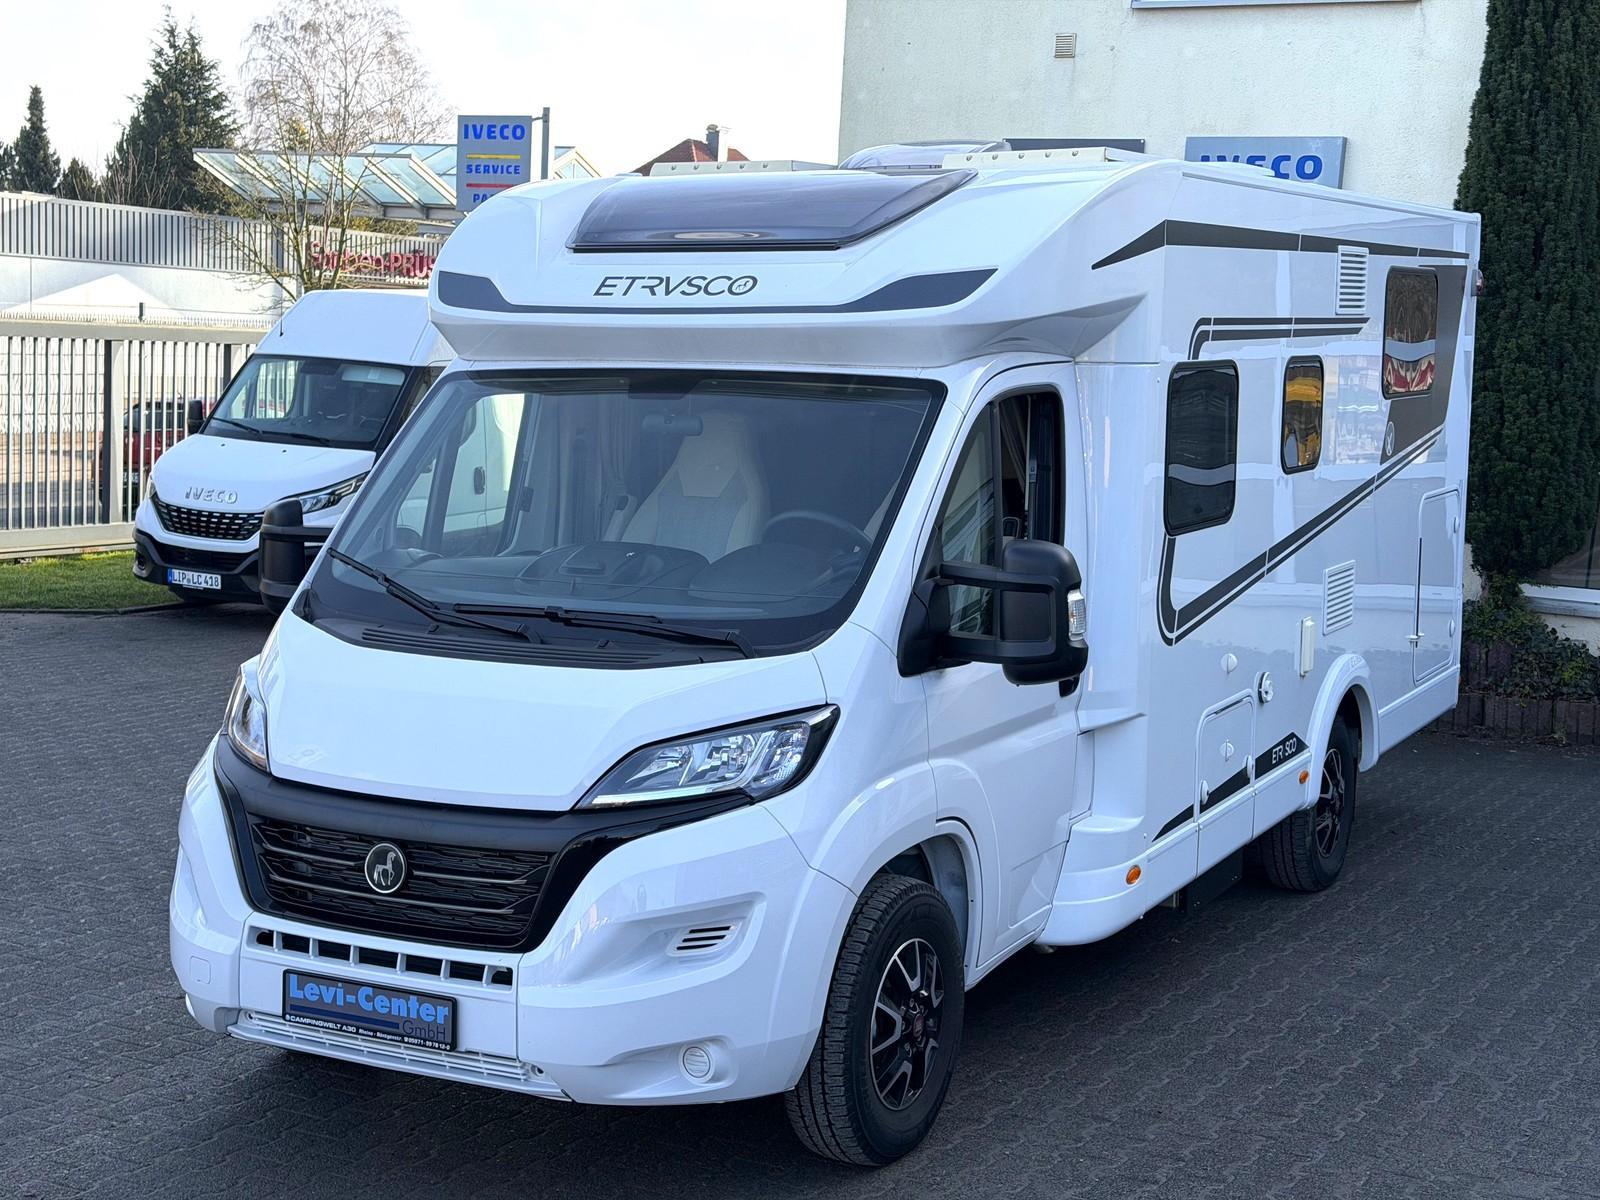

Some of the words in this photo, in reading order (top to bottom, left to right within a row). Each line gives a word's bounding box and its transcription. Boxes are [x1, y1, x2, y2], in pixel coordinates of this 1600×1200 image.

[463, 123, 526, 140] IVECO
[465, 163, 521, 175] SERVICE
[185, 486, 239, 505] IVECO
[172, 570, 187, 583] LIP
[191, 573, 202, 585] LC
[203, 575, 220, 588] 418
[289, 974, 449, 1024] Levi-Center
[290, 1015, 342, 1030] CAMPINGWELT
[342, 1025, 357, 1033] A30
[402, 1019, 446, 1042] GmbH
